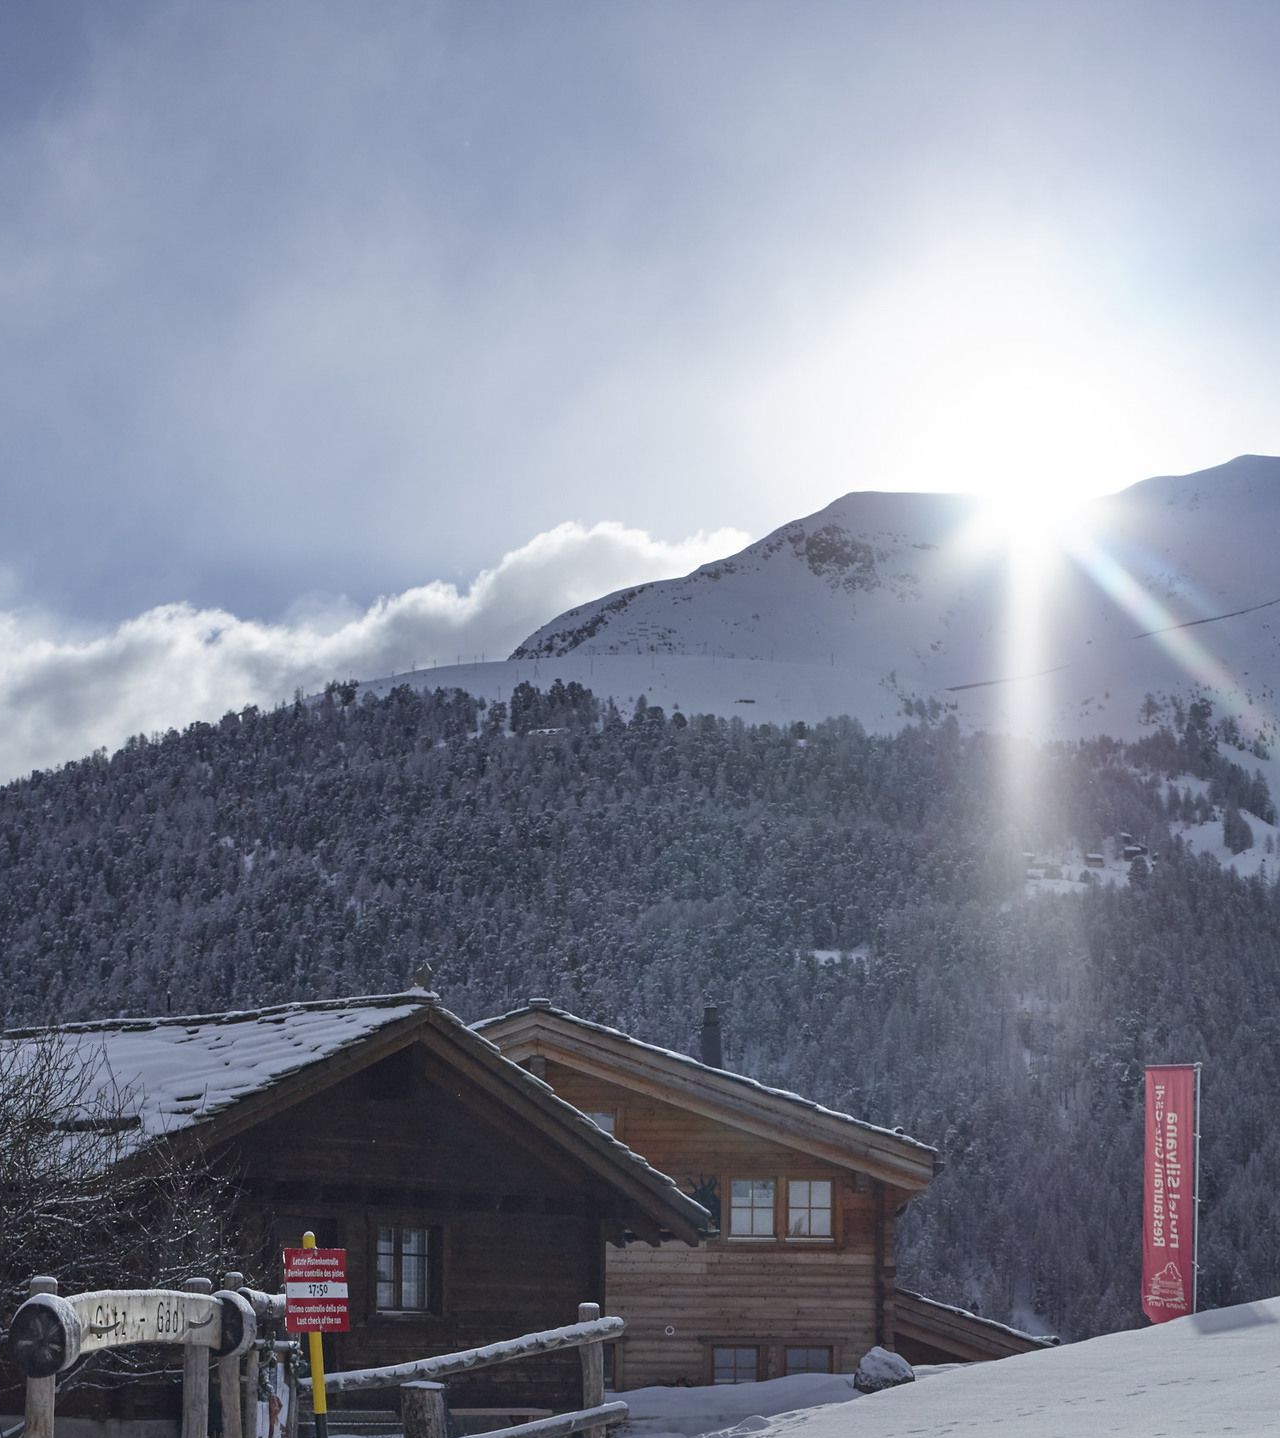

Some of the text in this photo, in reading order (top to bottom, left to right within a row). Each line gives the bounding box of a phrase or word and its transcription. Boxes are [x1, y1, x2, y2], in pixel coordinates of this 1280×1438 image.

[292, 1257, 339, 1266] Letzte Pistenkontrolle
[287, 1269, 304, 1277] Dernier
[331, 1269, 344, 1279] pistes
[308, 1284, 328, 1296] 17:50
[288, 1304, 304, 1313] Ultimo
[305, 1304, 325, 1312] controllo
[325, 1304, 336, 1312] della
[157, 1300, 185, 1334] Gädi
[296, 1316, 307, 1325] Last
[307, 1315, 321, 1325] check
[326, 1316, 334, 1324] the
